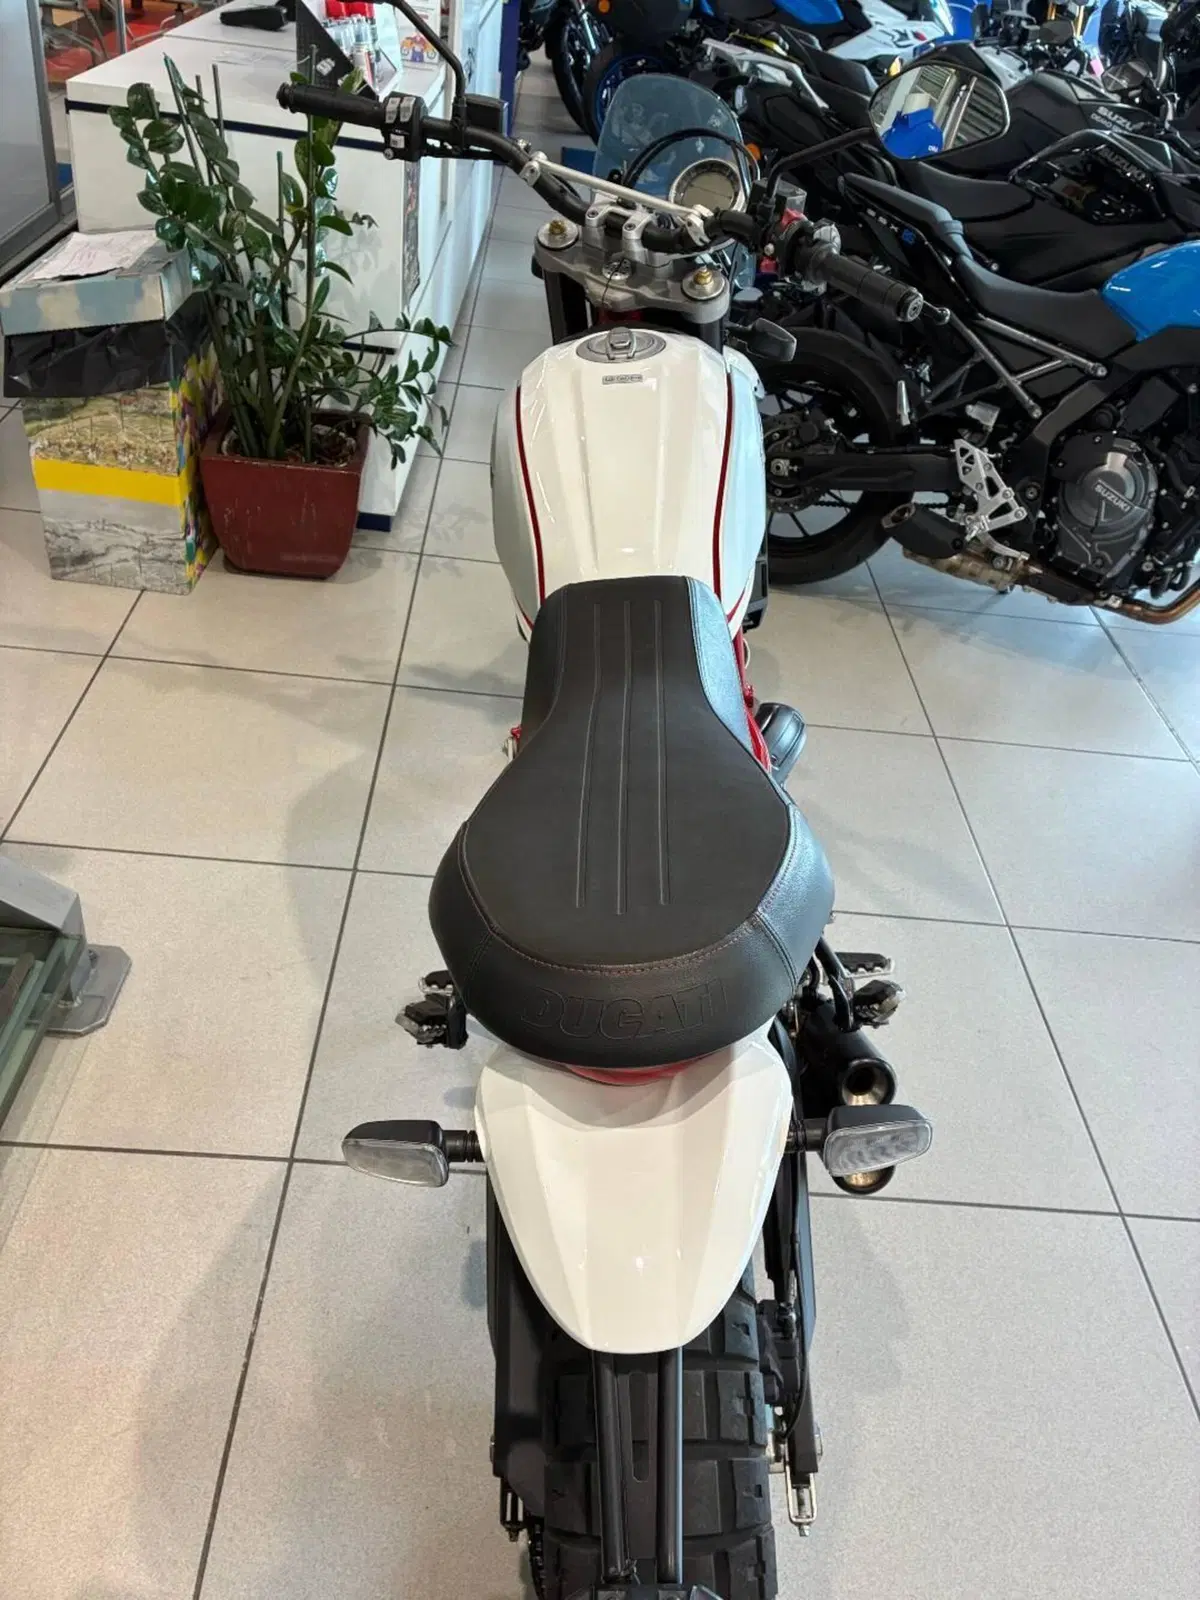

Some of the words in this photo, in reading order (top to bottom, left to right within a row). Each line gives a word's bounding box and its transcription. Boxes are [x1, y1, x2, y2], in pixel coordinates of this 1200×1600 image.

[1096, 106, 1133, 131] SUZU
[1095, 484, 1131, 512] SUZUKI
[520, 978, 728, 1040] DUCATI
